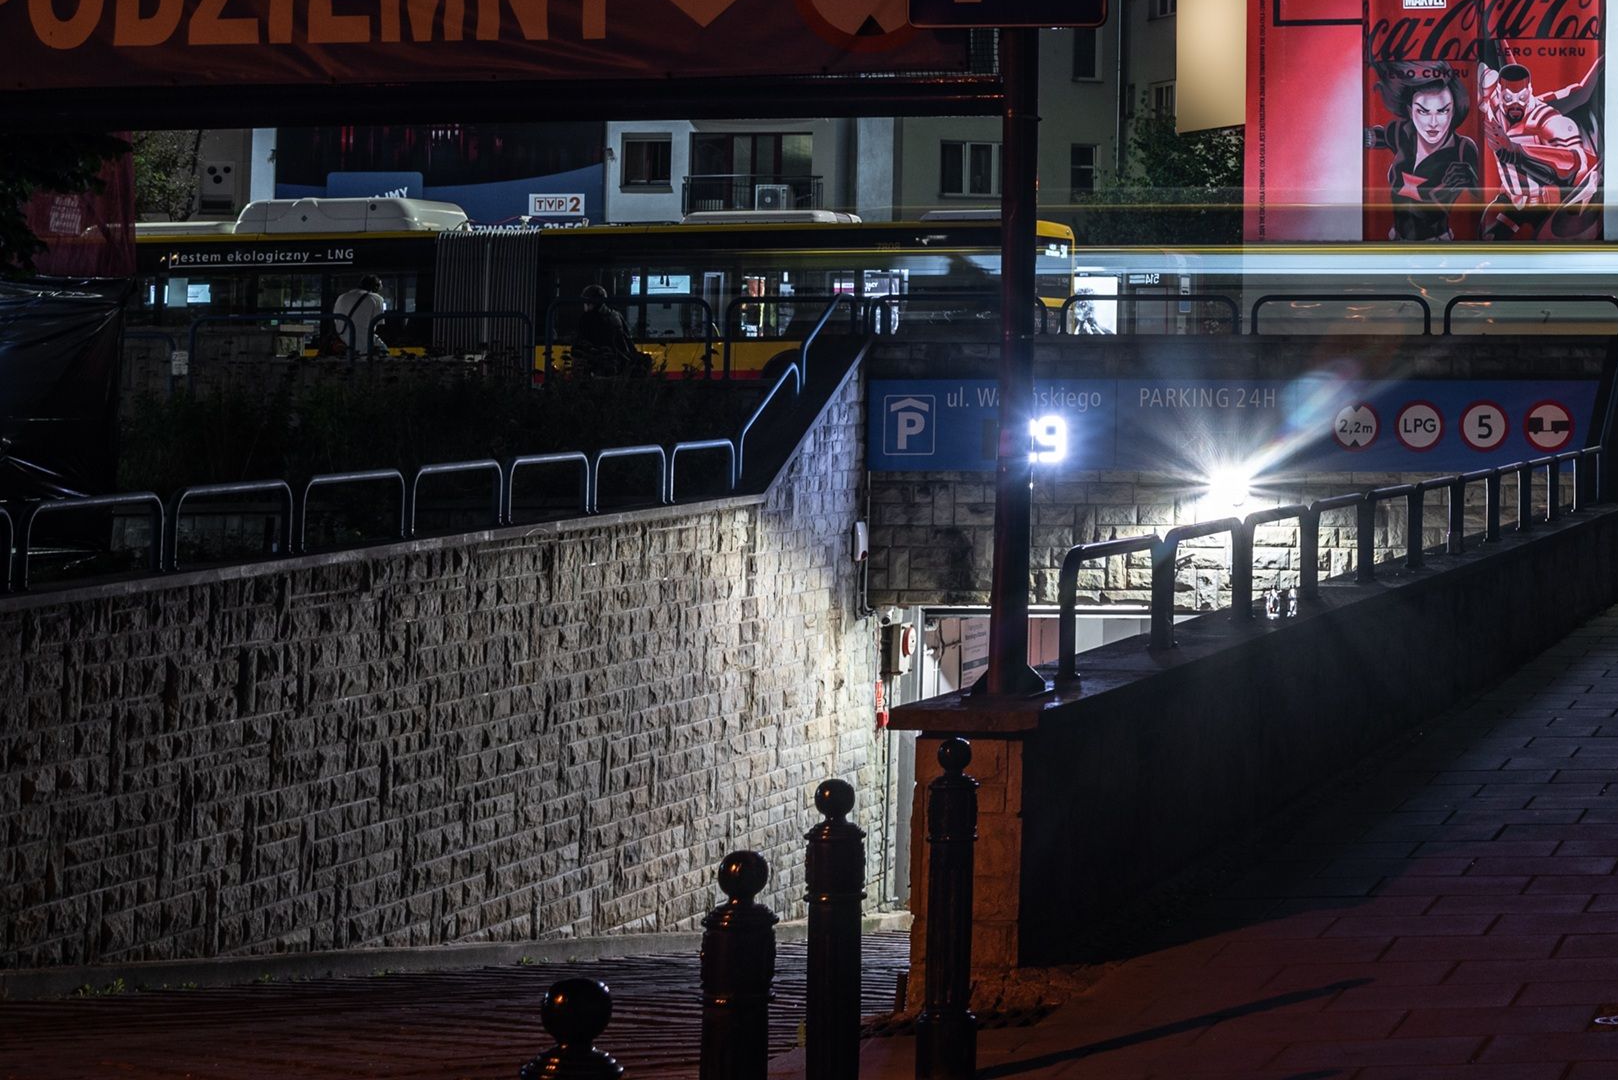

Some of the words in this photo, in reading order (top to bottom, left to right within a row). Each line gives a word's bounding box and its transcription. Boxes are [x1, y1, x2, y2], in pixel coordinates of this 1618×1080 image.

[1537, 46, 1586, 57] CUKRU
[1422, 68, 1469, 79] CUKRU
[227, 250, 310, 264] ekologiczny
[328, 248, 354, 260] LNG
[947, 387, 969, 407] ul.
[1139, 387, 1229, 408] PARKING
[1236, 387, 1276, 408] 24H
[897, 412, 925, 450] P
[1339, 418, 1373, 435] 2,2m
[1403, 418, 1437, 433] LPG
[1478, 415, 1492, 439] 5
